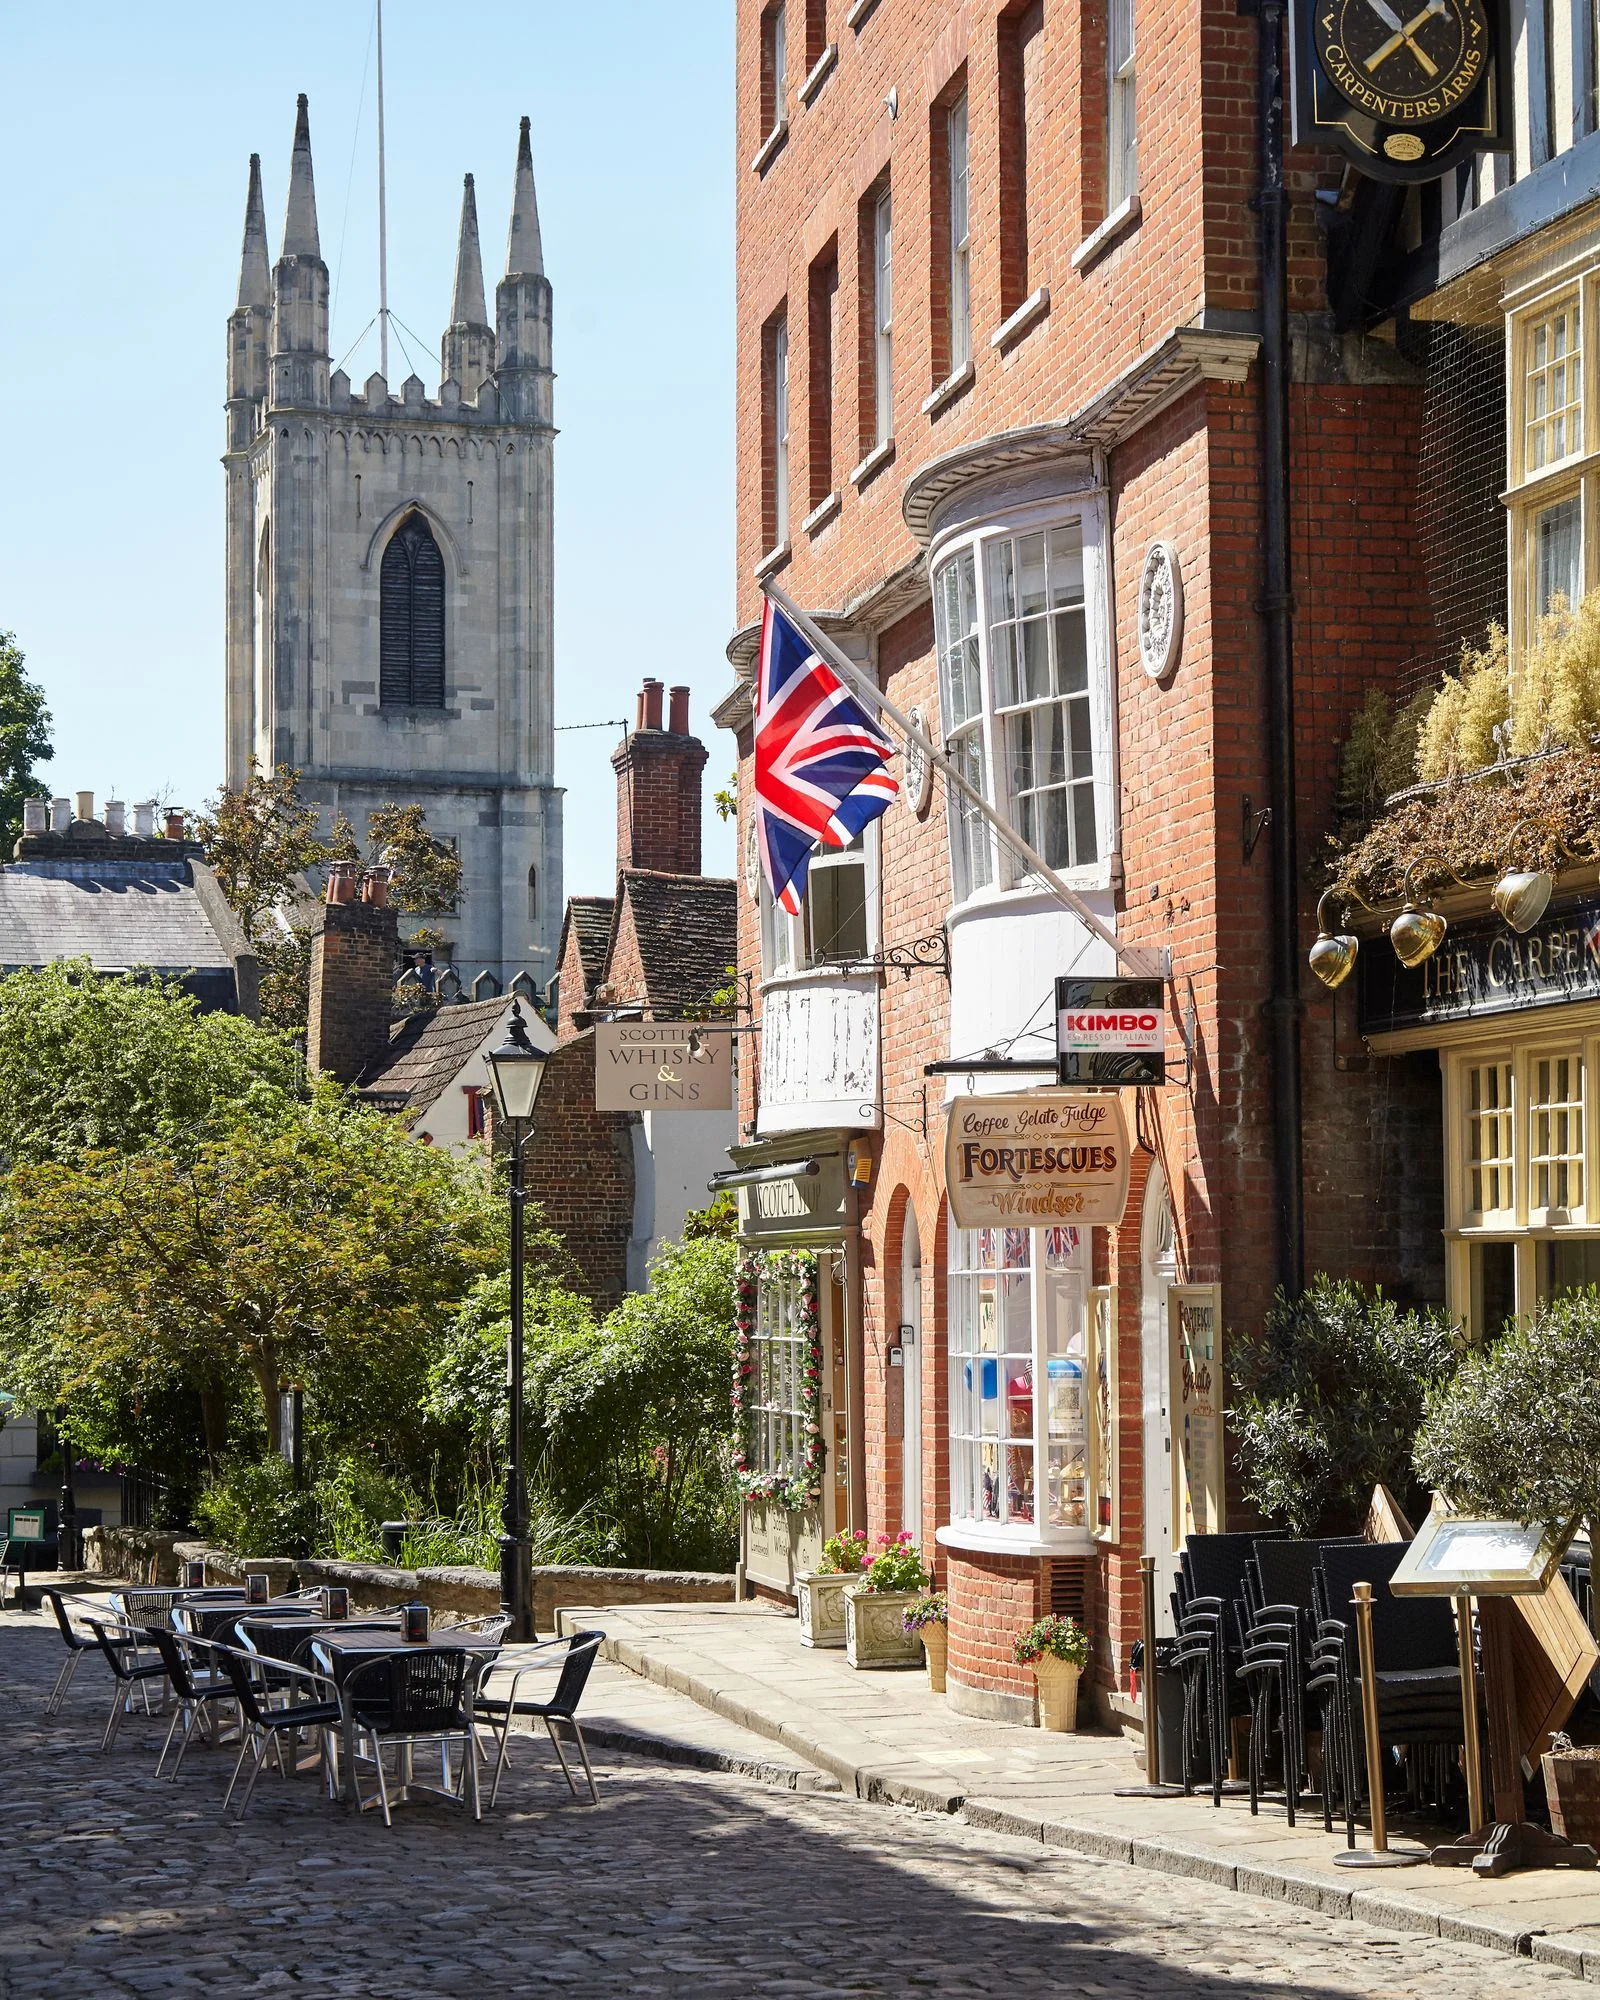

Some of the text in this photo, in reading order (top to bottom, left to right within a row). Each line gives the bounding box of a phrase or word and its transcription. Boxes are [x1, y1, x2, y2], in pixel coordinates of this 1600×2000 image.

[1325, 44, 1481, 119] CARPENTERS ARMS
[1421, 950, 1469, 999] THE
[619, 1029, 709, 1041] SCOTTI
[1067, 1014, 1157, 1031] KIMBO
[1067, 1033, 1158, 1041] ESPRESSO ITALIANO
[657, 1065, 682, 1082] &
[629, 1083, 700, 1101] GINS
[962, 1102, 1108, 1137] Coffee Gelato Fudge
[956, 1142, 1118, 1183] FORTESCUES
[758, 1182, 795, 1217] SCOTCH
[991, 1188, 1086, 1217] Windsor
